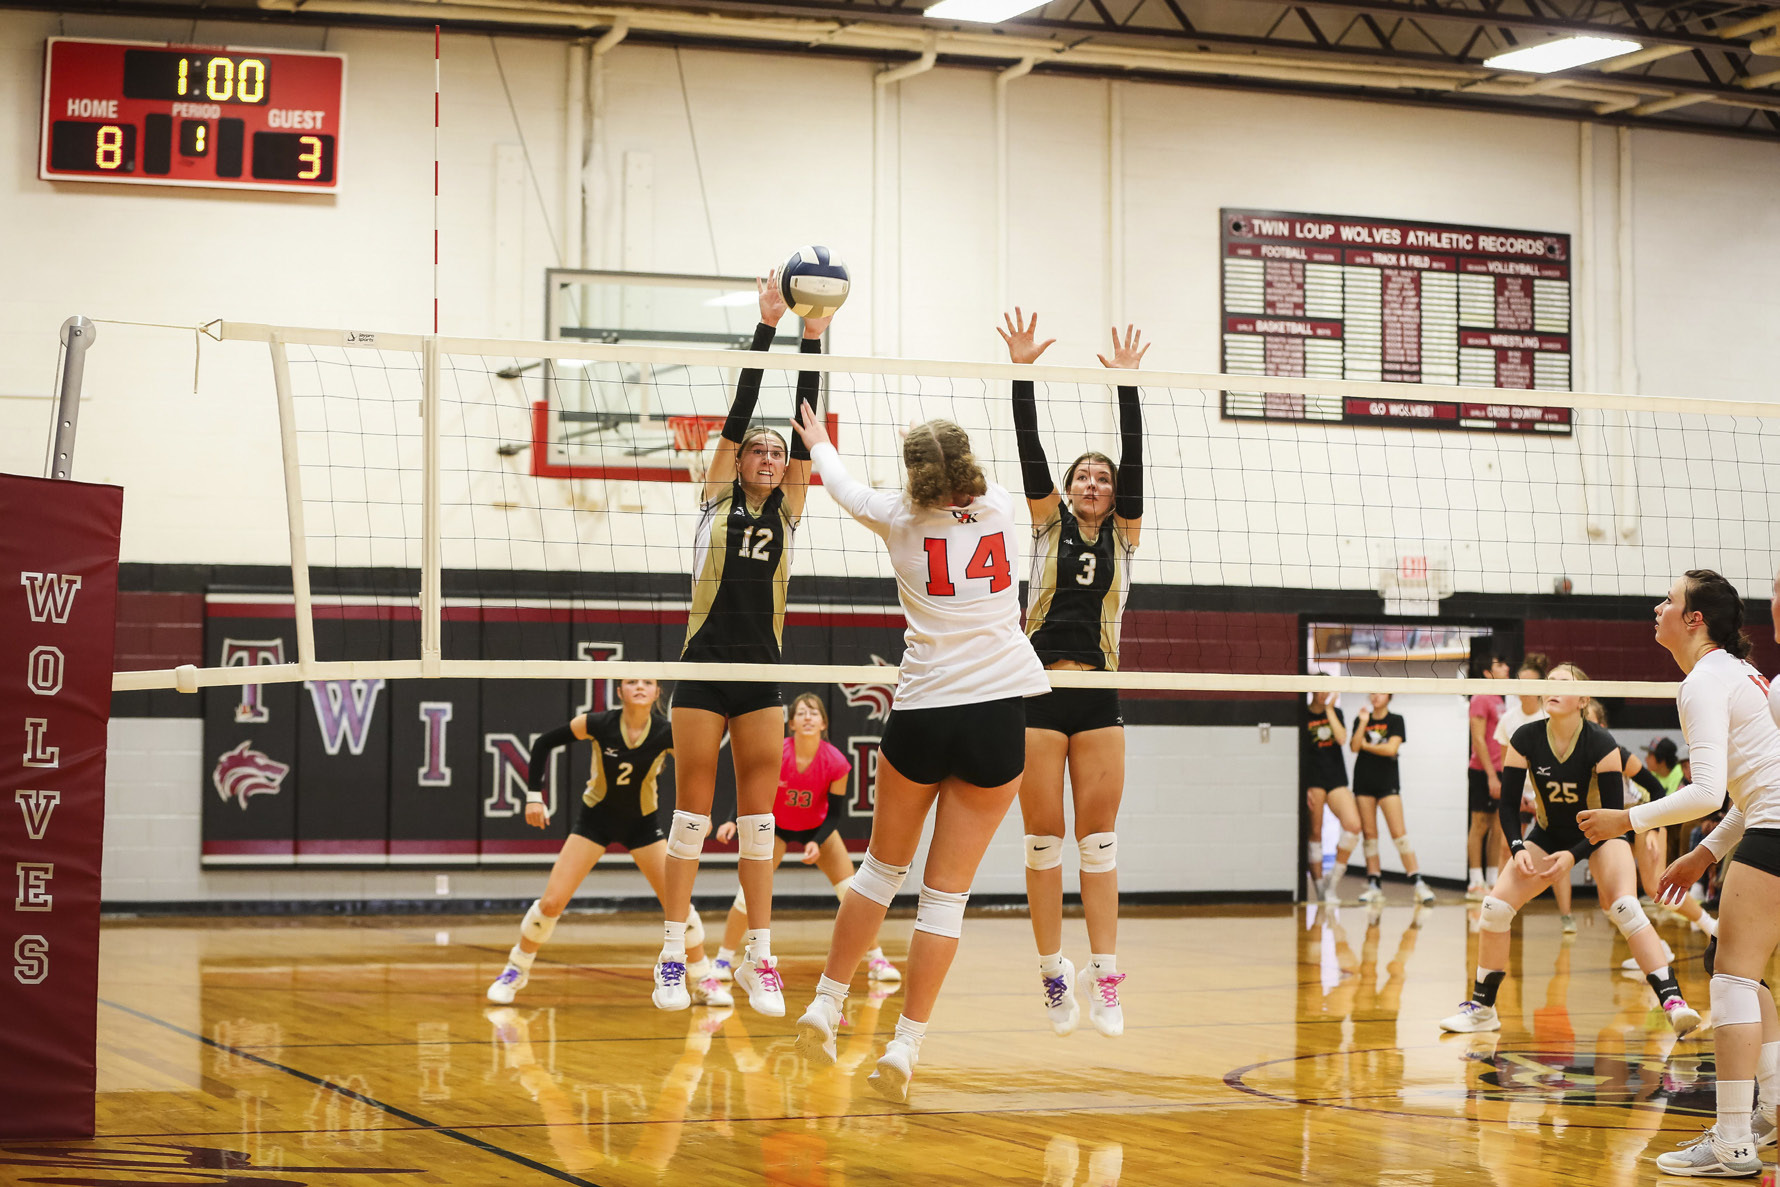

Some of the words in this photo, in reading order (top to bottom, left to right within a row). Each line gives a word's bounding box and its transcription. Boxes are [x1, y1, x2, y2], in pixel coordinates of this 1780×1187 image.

[177, 57, 265, 102] 1:00
[67, 98, 119, 119] HOME
[172, 102, 221, 120] PERIOD
[268, 108, 325, 130] GUEST
[95, 125, 123, 170] 8
[195, 125, 206, 152] 1
[298, 135, 323, 180] 3
[1252, 219, 1290, 237] TWIN
[1295, 222, 1335, 240] LOUP
[1340, 225, 1402, 245] WOLVES
[1406, 230, 1473, 250] ATHLETIC
[1478, 235, 1545, 256] RECORDS
[1260, 245, 1307, 260] FOOTBALL
[1486, 261, 1540, 277] VOLLEYBALL
[1255, 320, 1313, 335] BASKETBALL
[1489, 334, 1540, 349] WRESTLING
[737, 525, 775, 562] 12
[923, 531, 1012, 597] 14
[1075, 552, 1097, 586] 3
[14, 571, 82, 985] WOLVES
[616, 762, 633, 786] 2
[785, 789, 813, 808] 33
[1546, 781, 1579, 804] 25
